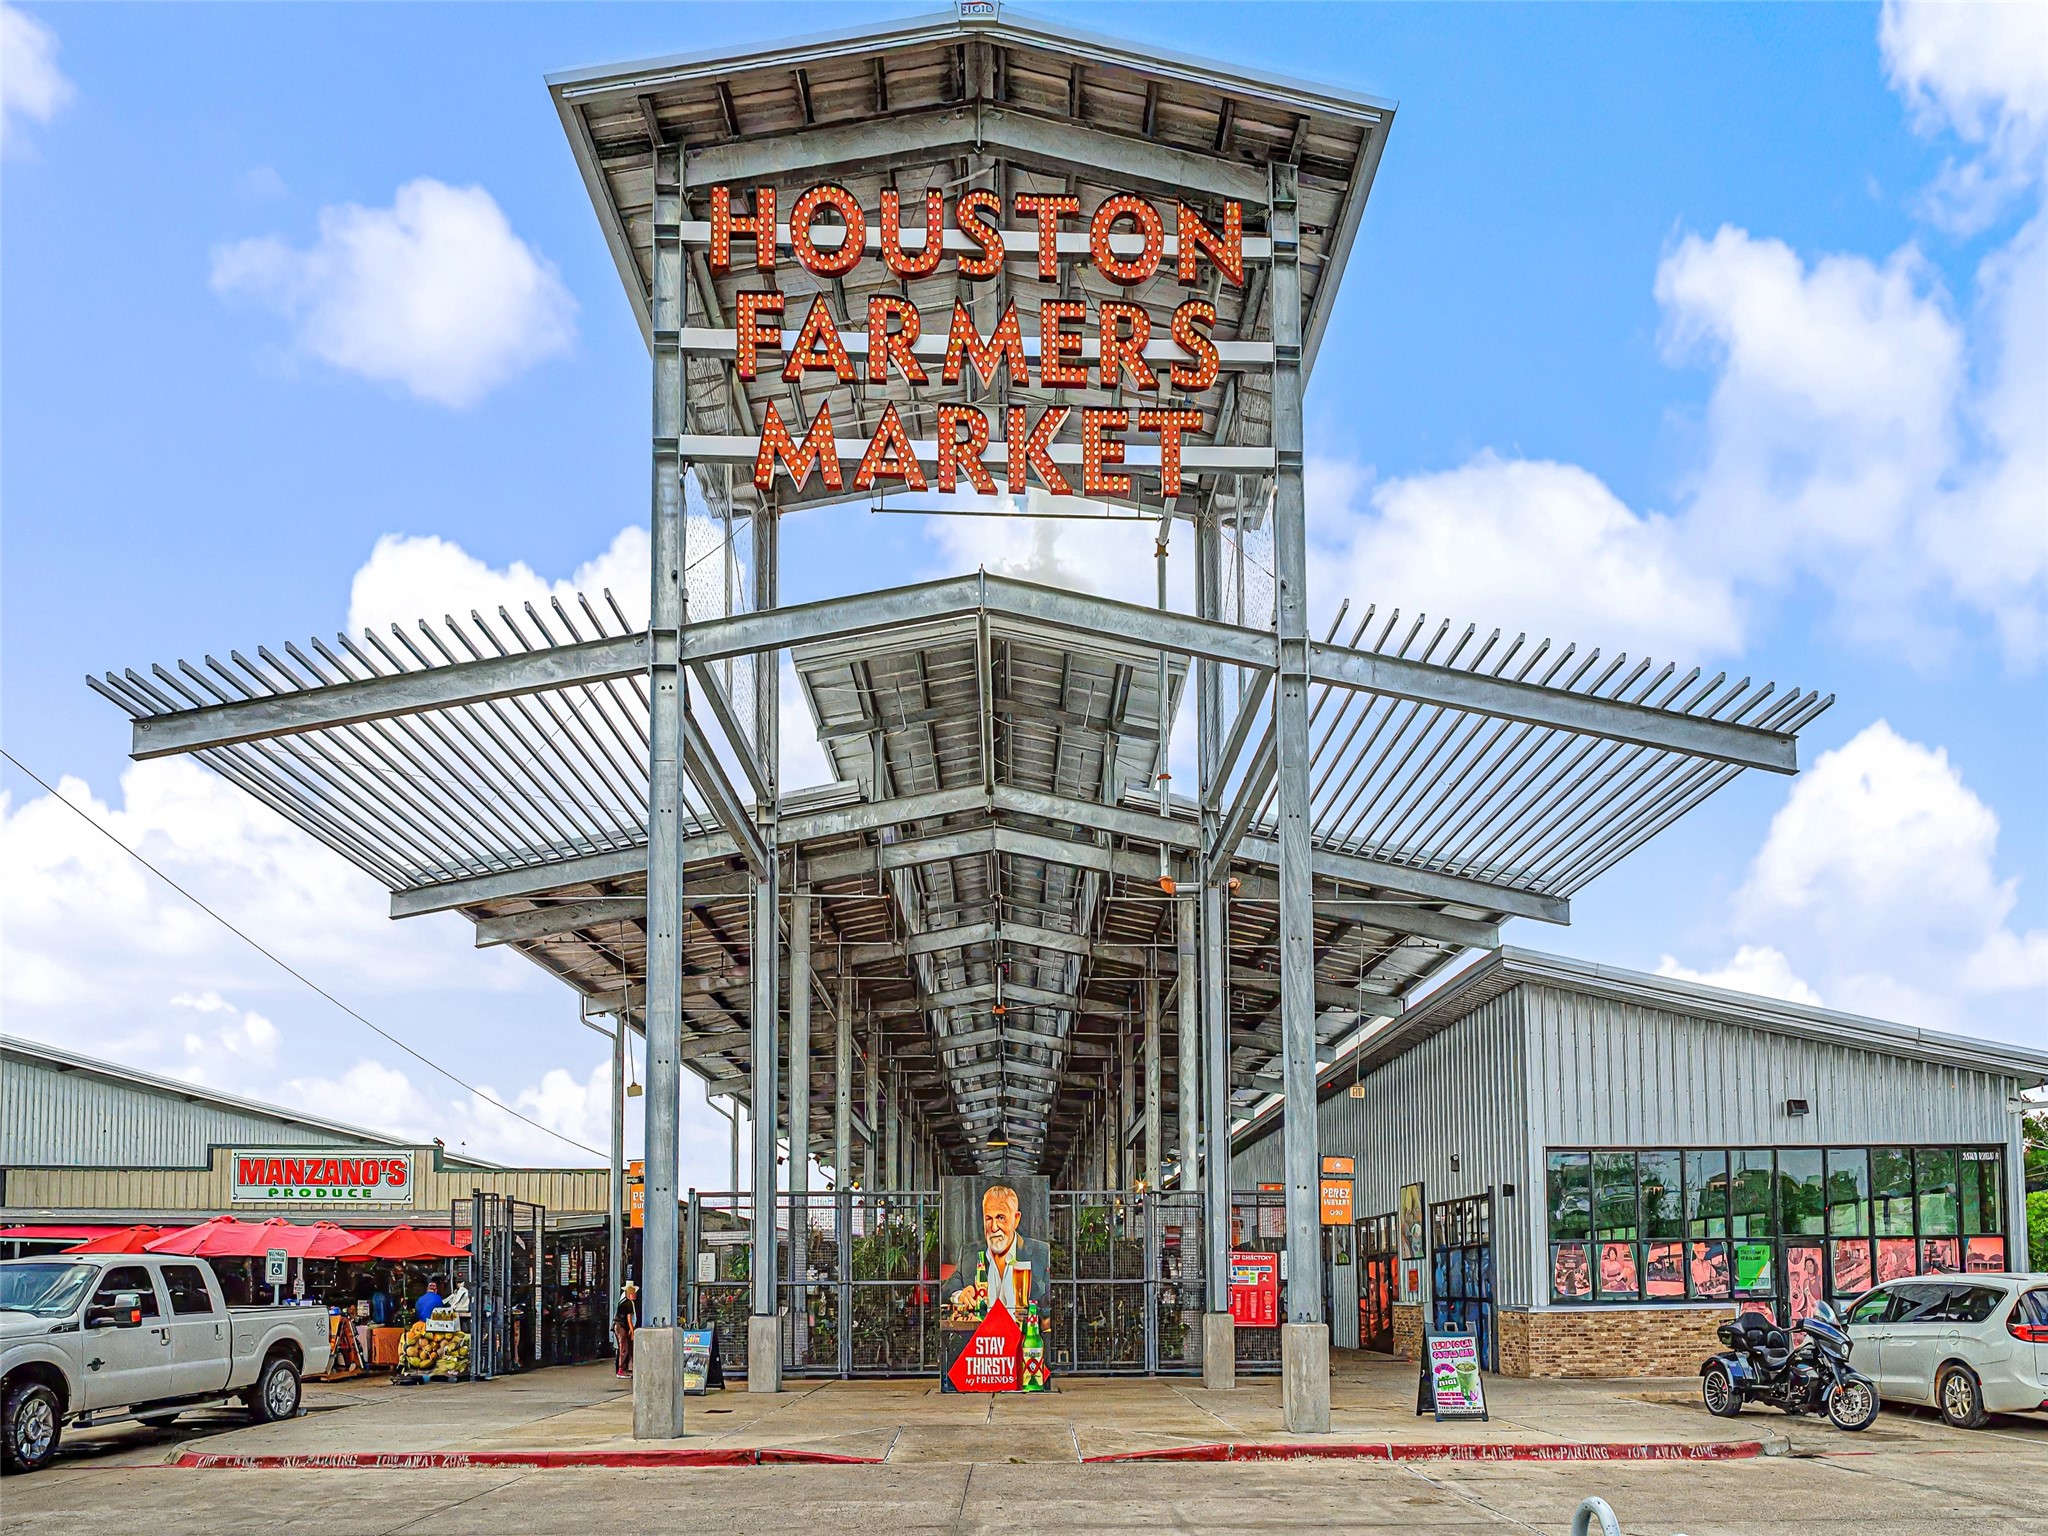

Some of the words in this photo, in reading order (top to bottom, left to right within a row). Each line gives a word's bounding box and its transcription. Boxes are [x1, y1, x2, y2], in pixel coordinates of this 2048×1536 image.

[709, 184, 1245, 288] HOUSTON
[735, 290, 1221, 393] FARMERS
[753, 399, 1203, 499] MARKET
[238, 1158, 408, 1187] MANZANO'S
[268, 1188, 372, 1198] PRODUCE
[975, 1336, 1005, 1355] STAY
[965, 1356, 1015, 1376] THIRSTY
[976, 1375, 1015, 1384] FRIENDS
[1481, 1446, 1515, 1460] LANE
[1560, 1446, 1610, 1461] PARKING
